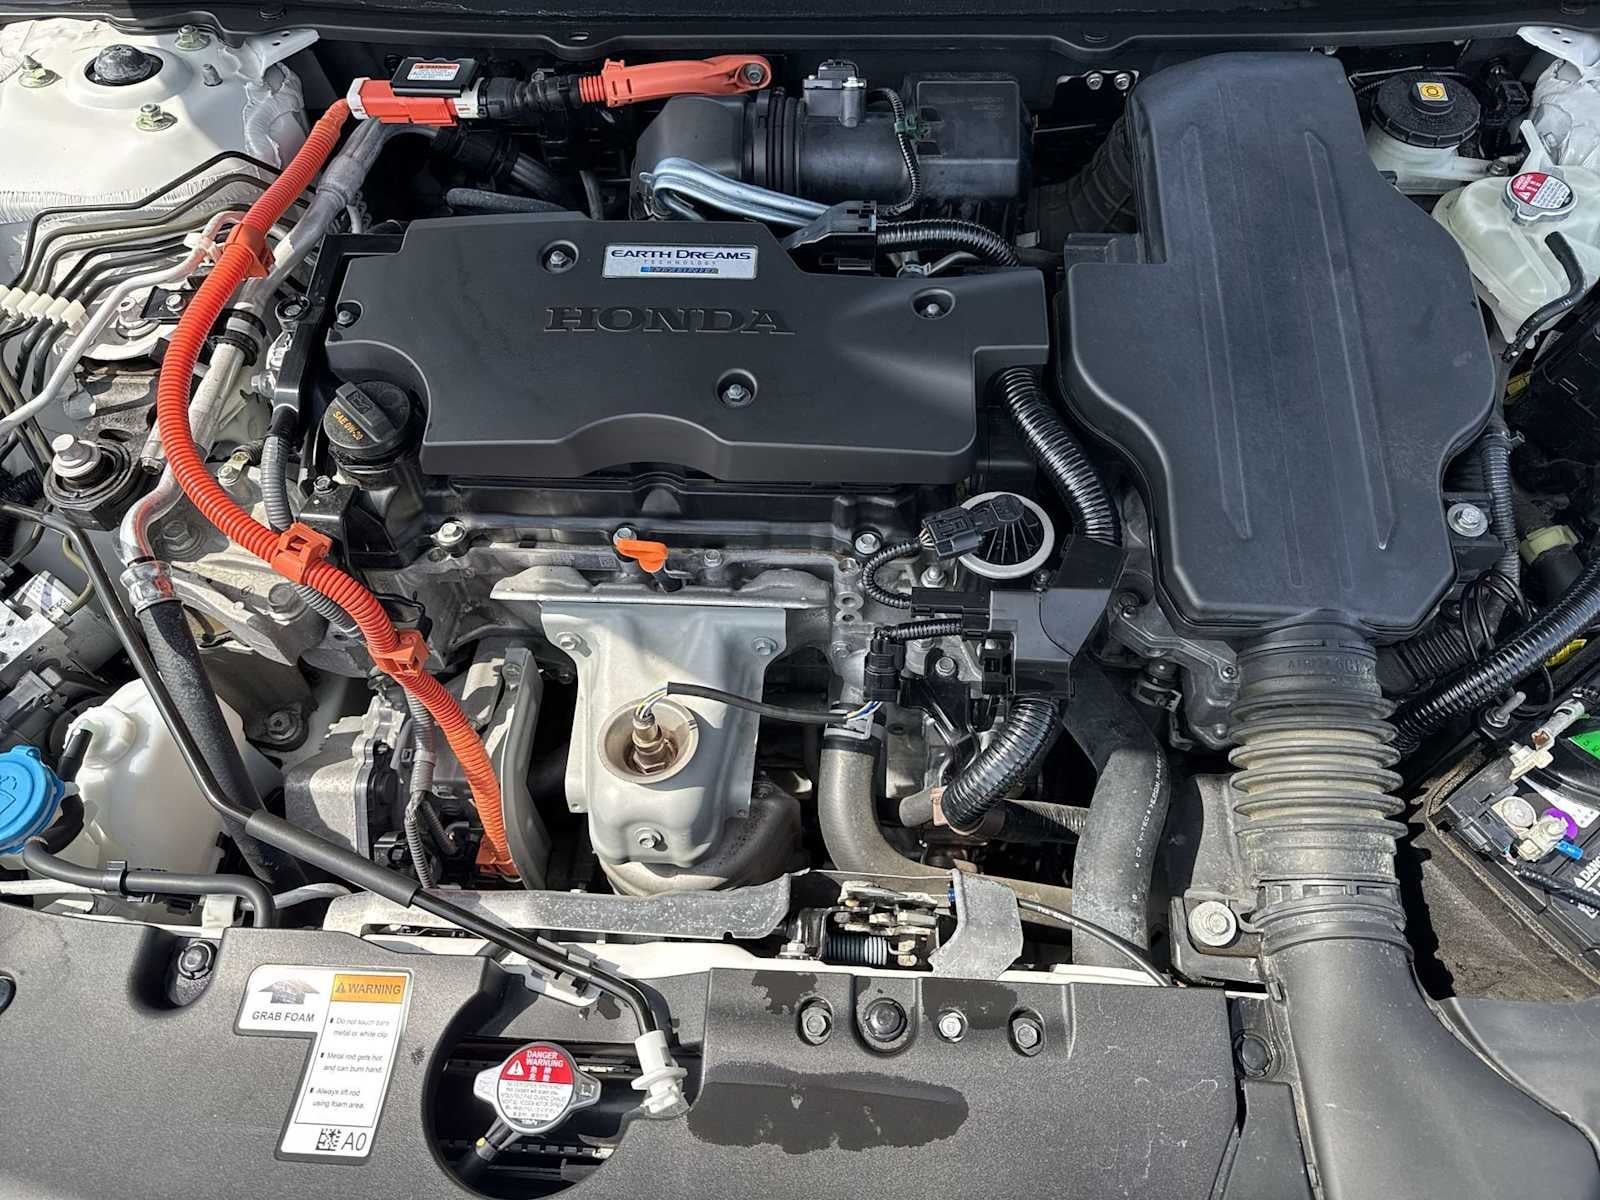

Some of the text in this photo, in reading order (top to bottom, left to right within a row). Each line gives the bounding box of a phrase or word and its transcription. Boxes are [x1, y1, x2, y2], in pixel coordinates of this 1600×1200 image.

[611, 249, 751, 260] EARTH DREAMS
[543, 306, 796, 335] HONDA
[333, 410, 349, 425] SAE
[348, 983, 401, 995] WARNING
[252, 1011, 315, 1022] GRAB FOAM
[526, 1050, 558, 1060] DANGER
[526, 1058, 564, 1068] WARNING
[341, 1132, 367, 1151] A0
